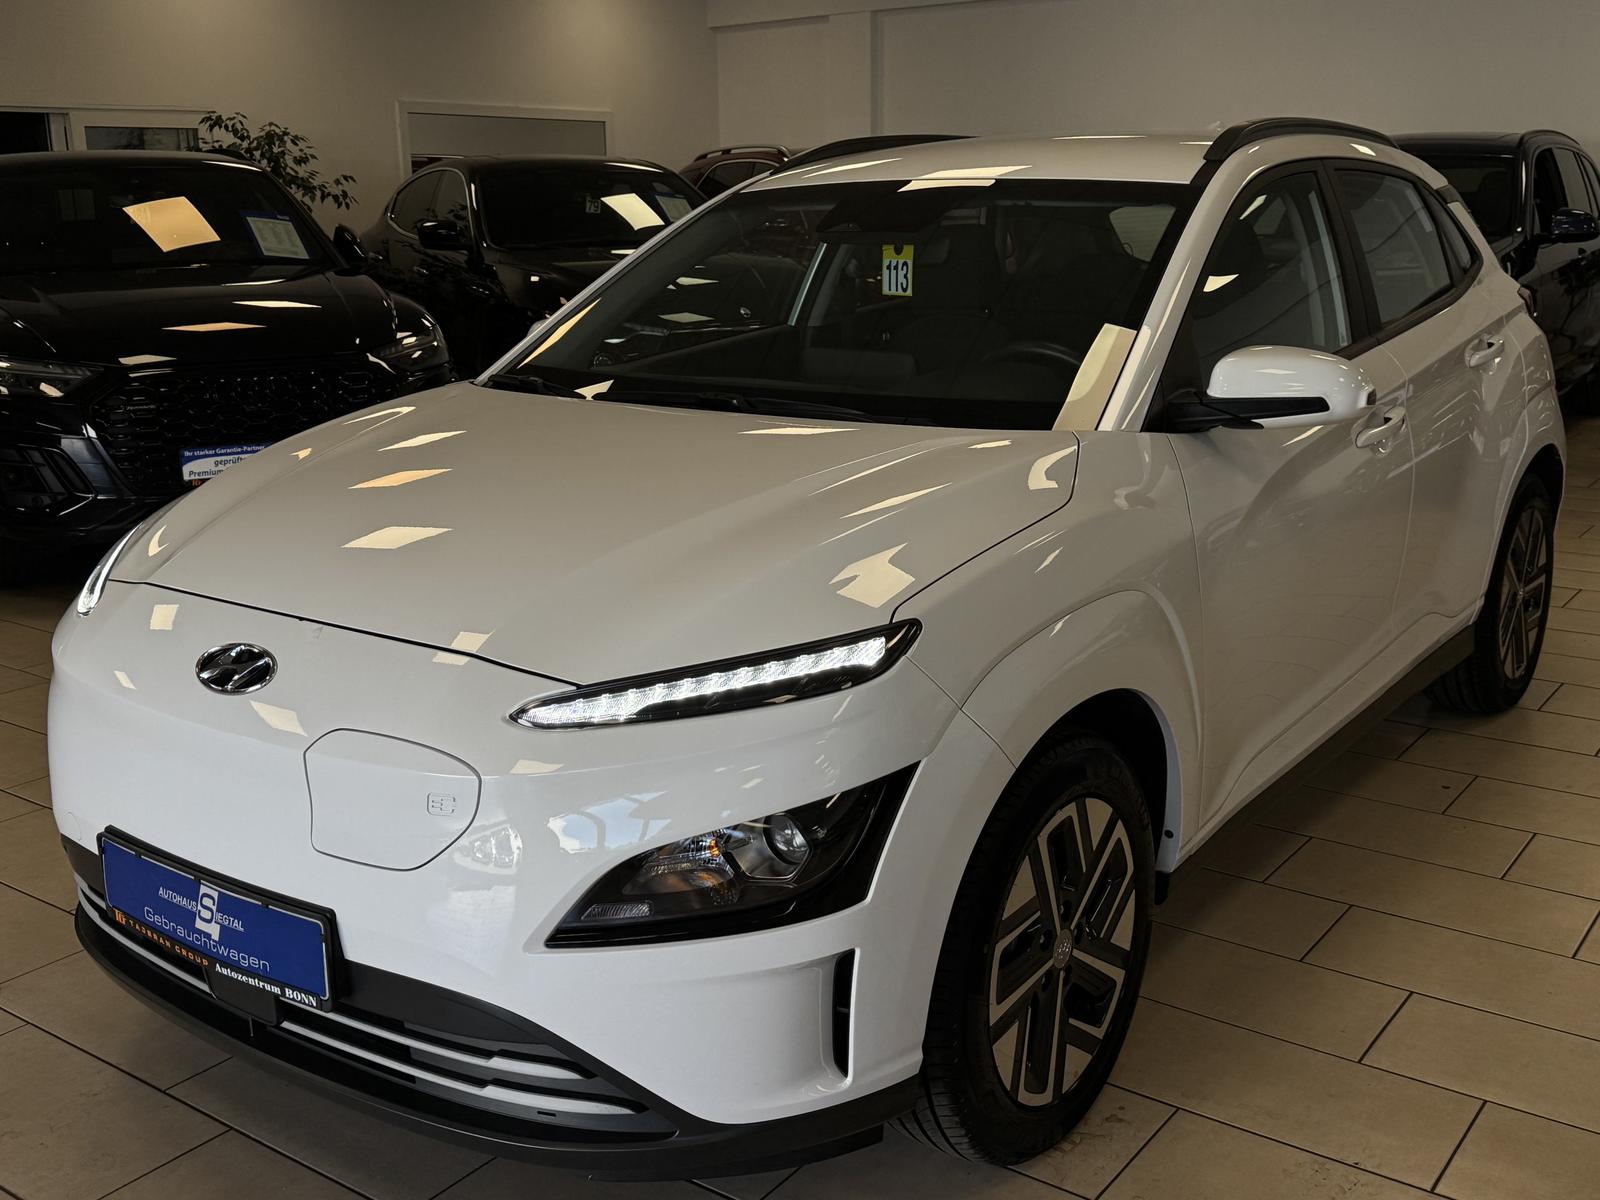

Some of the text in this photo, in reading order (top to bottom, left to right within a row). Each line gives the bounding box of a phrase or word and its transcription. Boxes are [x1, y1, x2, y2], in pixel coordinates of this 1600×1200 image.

[587, 200, 599, 212] 79
[886, 259, 909, 293] 113
[158, 886, 197, 912] AUTOHAUS
[144, 906, 270, 973] Gebrauchtwagen
[174, 945, 209, 967] GROUP
[215, 962, 317, 1008] Autozentrum BONN
